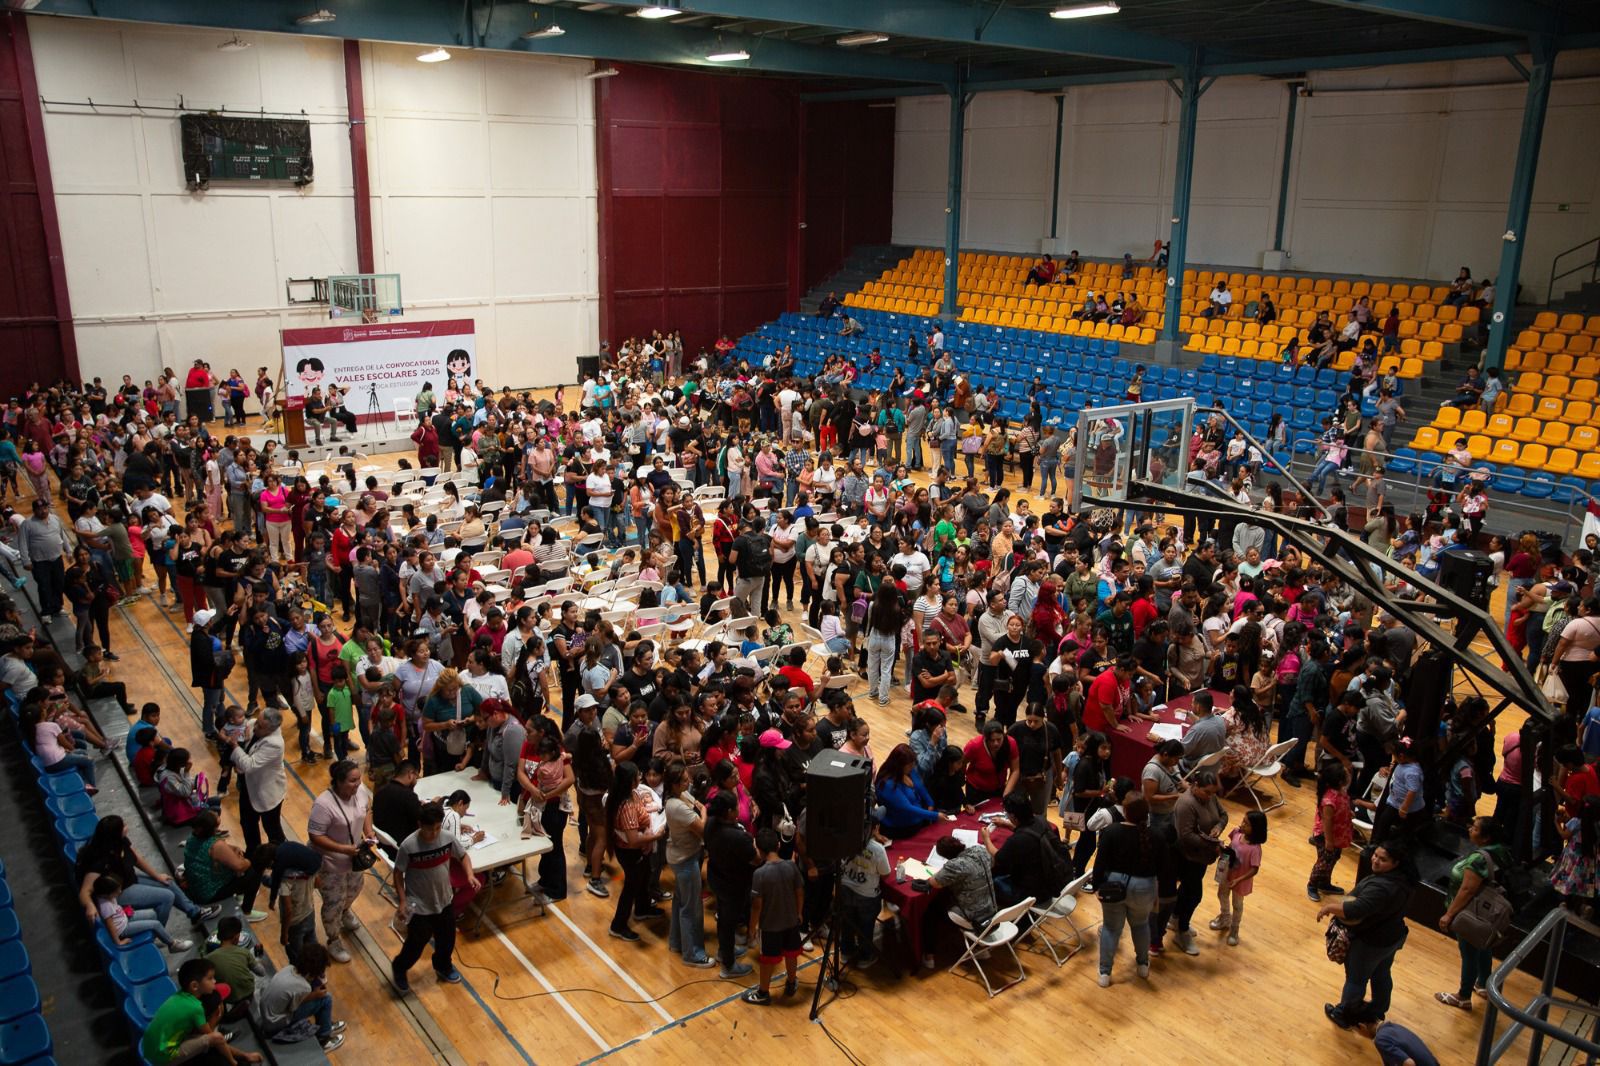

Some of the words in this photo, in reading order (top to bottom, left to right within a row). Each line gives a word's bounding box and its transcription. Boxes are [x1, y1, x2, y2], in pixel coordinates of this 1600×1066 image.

[334, 366, 365, 374] ENTREGA
[385, 359, 440, 369] CONVOCATORIA
[335, 374, 365, 383] VALES
[367, 369, 418, 381] ESCOLARES
[420, 367, 441, 376] 2025
[389, 380, 419, 388] ESTUDIAR
